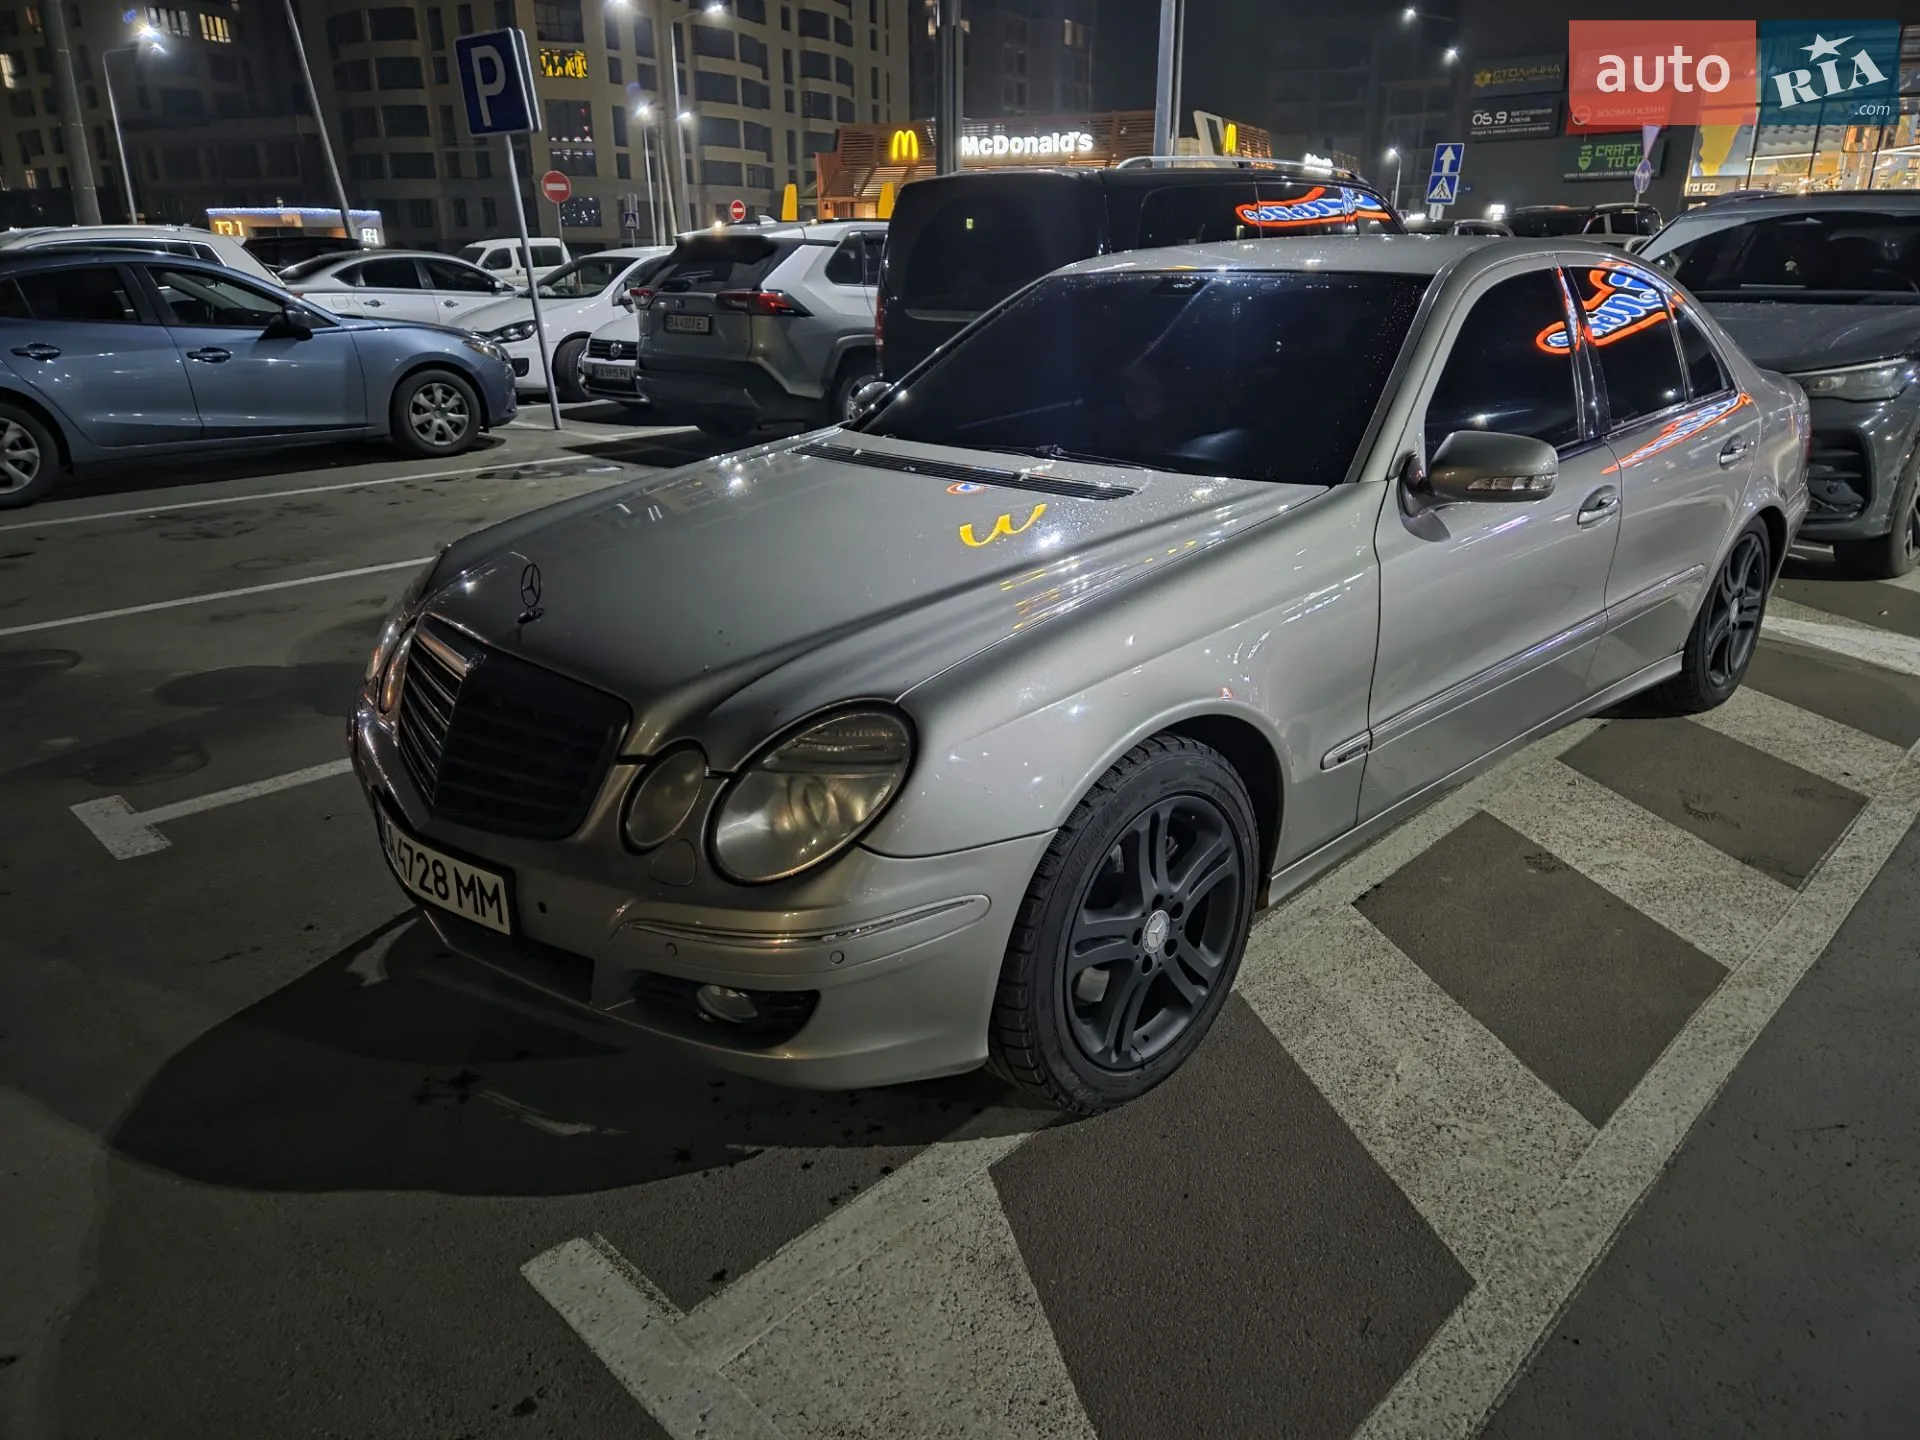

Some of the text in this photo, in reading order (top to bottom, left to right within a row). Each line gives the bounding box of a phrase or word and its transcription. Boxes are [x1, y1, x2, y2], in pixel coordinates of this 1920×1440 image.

[470, 45, 506, 126] P
[961, 131, 1094, 156] McDonald's
[1595, 144, 1641, 157] CRAFT
[1607, 156, 1624, 168] TO
[398, 838, 450, 901] 4728
[454, 866, 504, 925] MM
